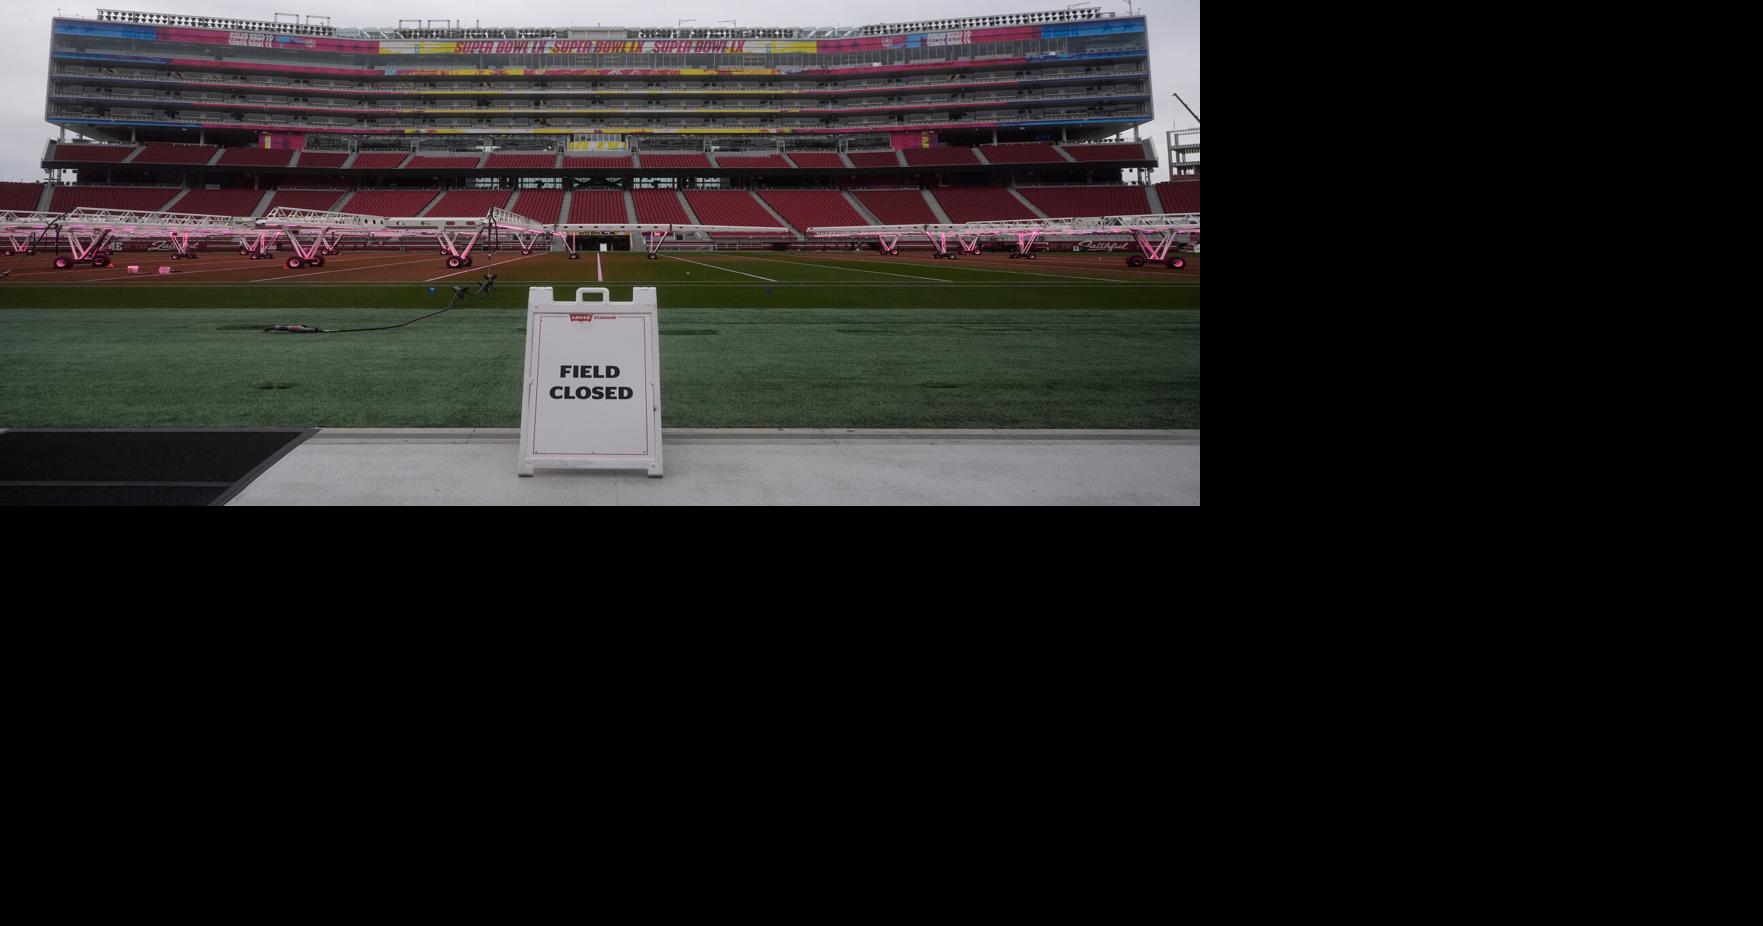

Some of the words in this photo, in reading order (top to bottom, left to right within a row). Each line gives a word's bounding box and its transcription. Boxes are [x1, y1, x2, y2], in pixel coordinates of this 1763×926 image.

[454, 41, 494, 54] SUPER
[496, 41, 529, 54] BOWL
[530, 41, 547, 54] LX
[552, 41, 593, 54] SUPER
[593, 41, 627, 53] BOWL
[626, 41, 645, 53] LX
[652, 41, 692, 53] SUPER
[694, 41, 729, 53] BOWL
[729, 41, 746, 53] LX
[1078, 240, 1129, 252] Faithful
[560, 366, 620, 378] FIELD
[549, 386, 633, 400] CLOSED
